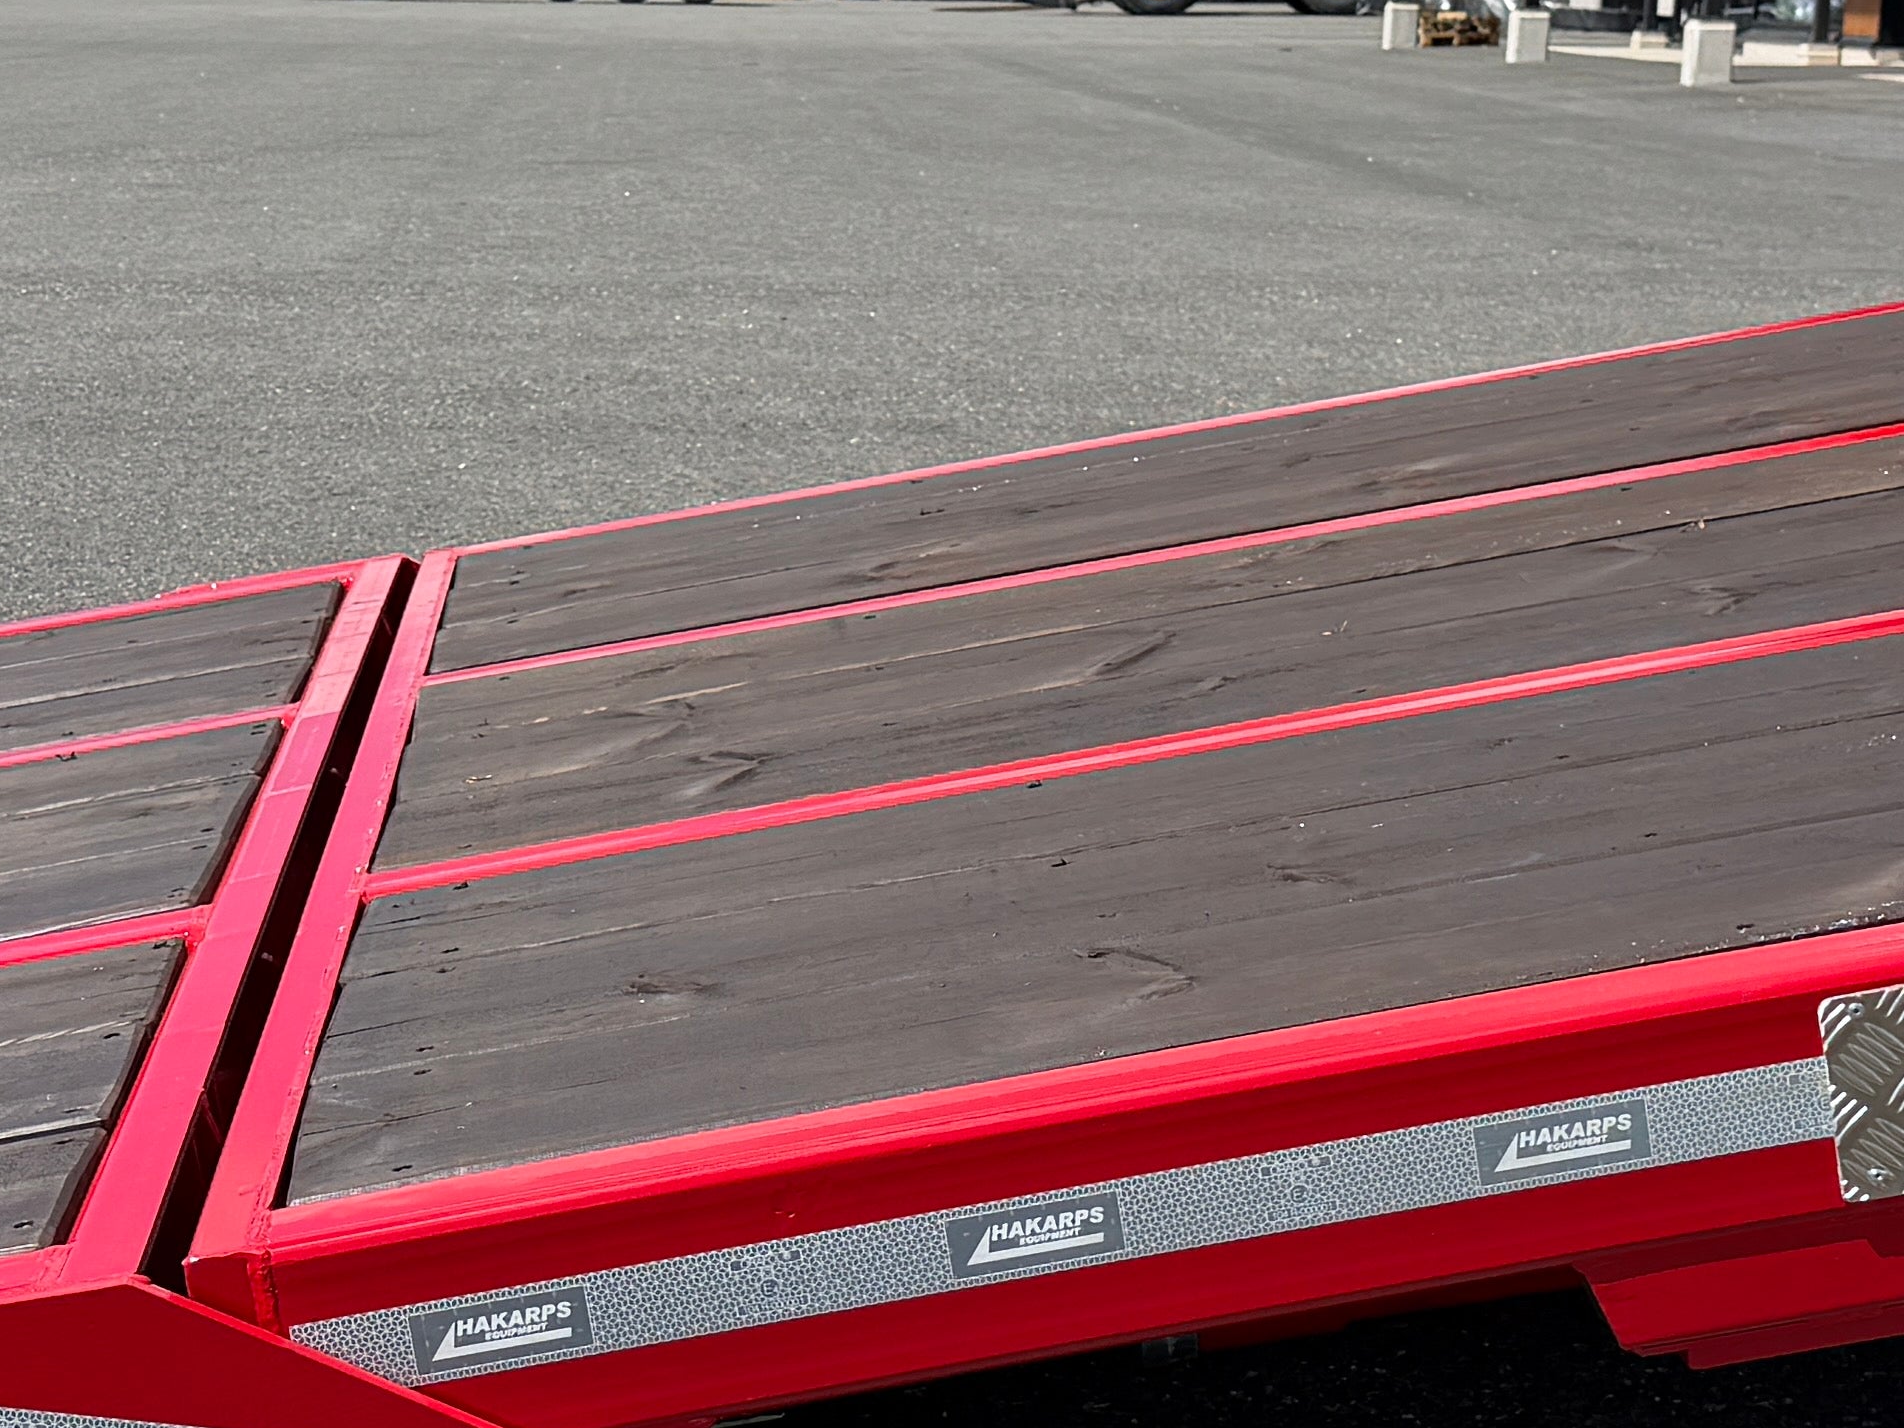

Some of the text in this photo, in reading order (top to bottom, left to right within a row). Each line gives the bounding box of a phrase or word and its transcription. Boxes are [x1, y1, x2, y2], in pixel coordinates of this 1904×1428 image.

[1519, 1114, 1632, 1148] HAKARPS
[1547, 1134, 1609, 1152] EQUIPMENT
[991, 1207, 1104, 1242] HAKARPS
[1020, 1227, 1082, 1245] EQUIPMENT
[457, 1301, 572, 1337] HAKARPS
[485, 1322, 548, 1341] EQUIPMENT
